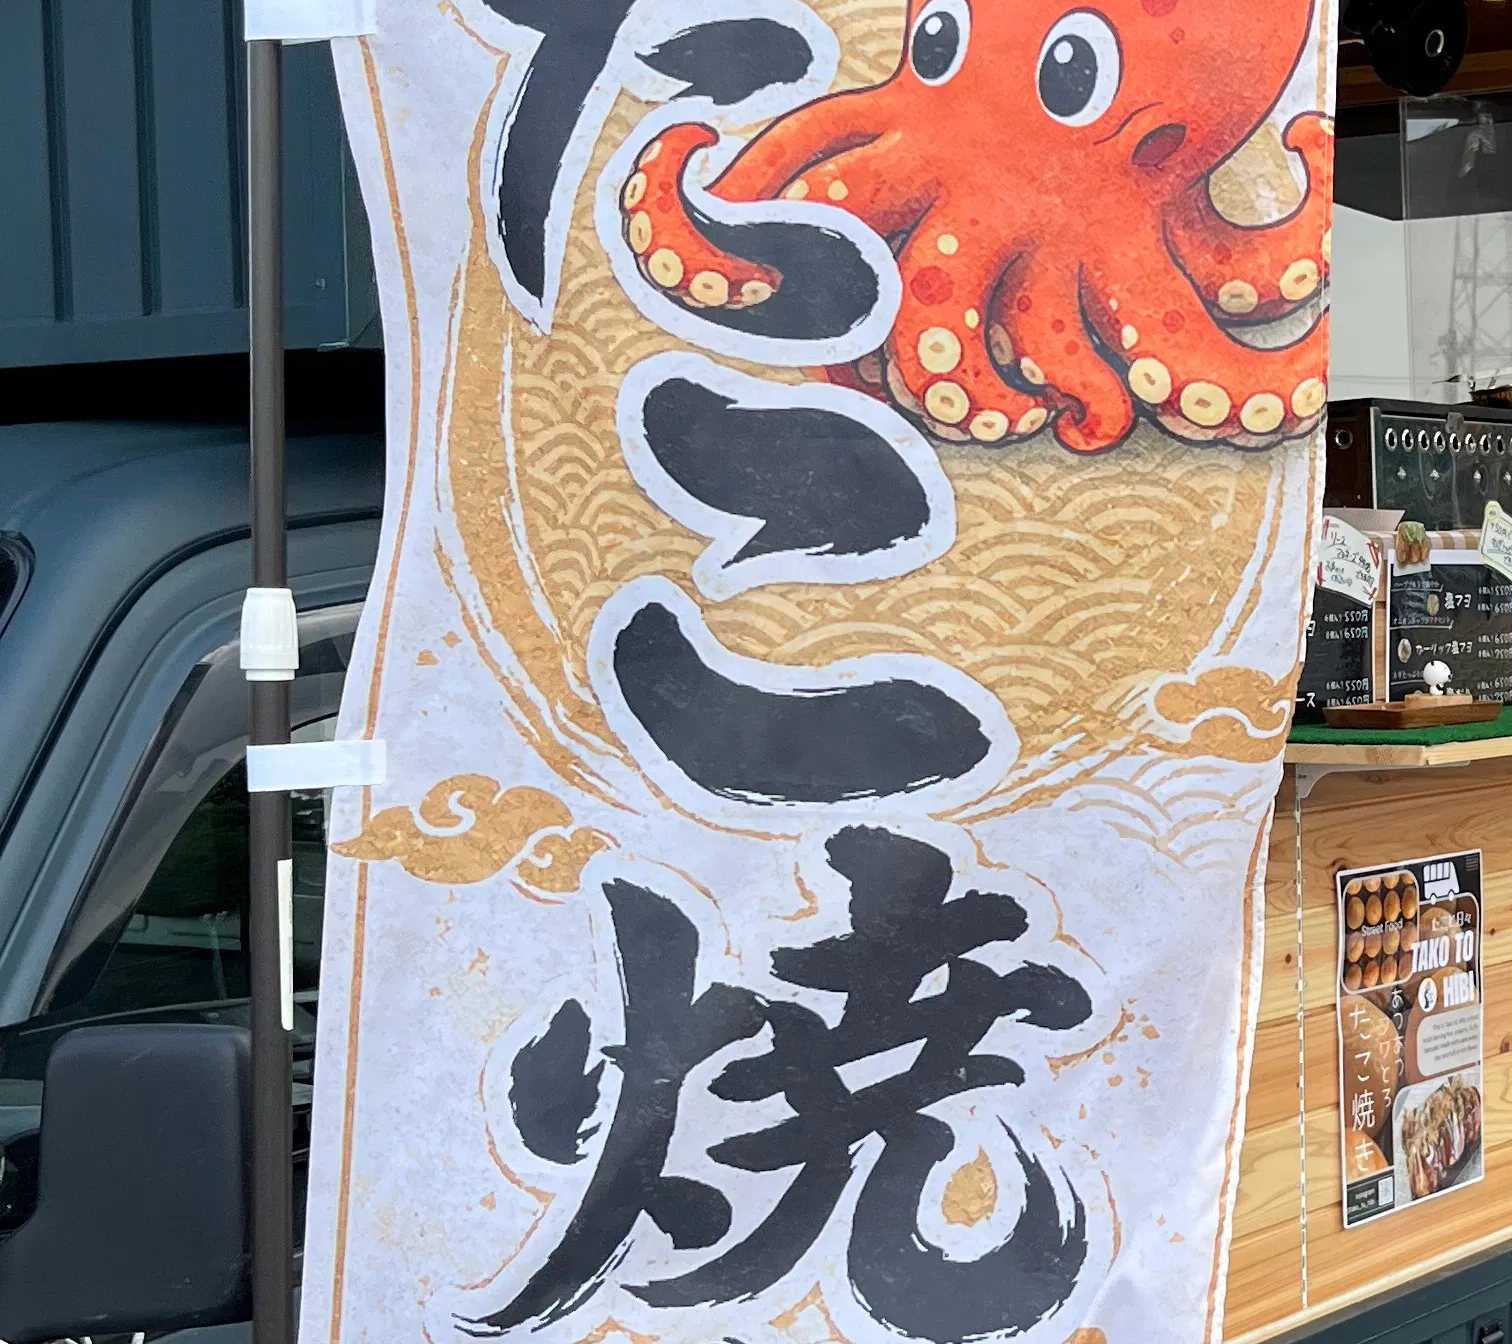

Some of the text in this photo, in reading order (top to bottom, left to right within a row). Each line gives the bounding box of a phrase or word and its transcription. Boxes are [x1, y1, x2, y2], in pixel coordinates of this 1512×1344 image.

[1344, 609, 1369, 623] 550円
[1344, 625, 1369, 639] 650円
[1345, 677, 1370, 692] 550円
[1361, 917, 1404, 937] Street Food
[1411, 929, 1475, 974] TAKO TO
[1442, 970, 1475, 1007] HIBI
[1391, 987, 1405, 1077] あつあつ
[1349, 1005, 1376, 1173] たこ焼き
